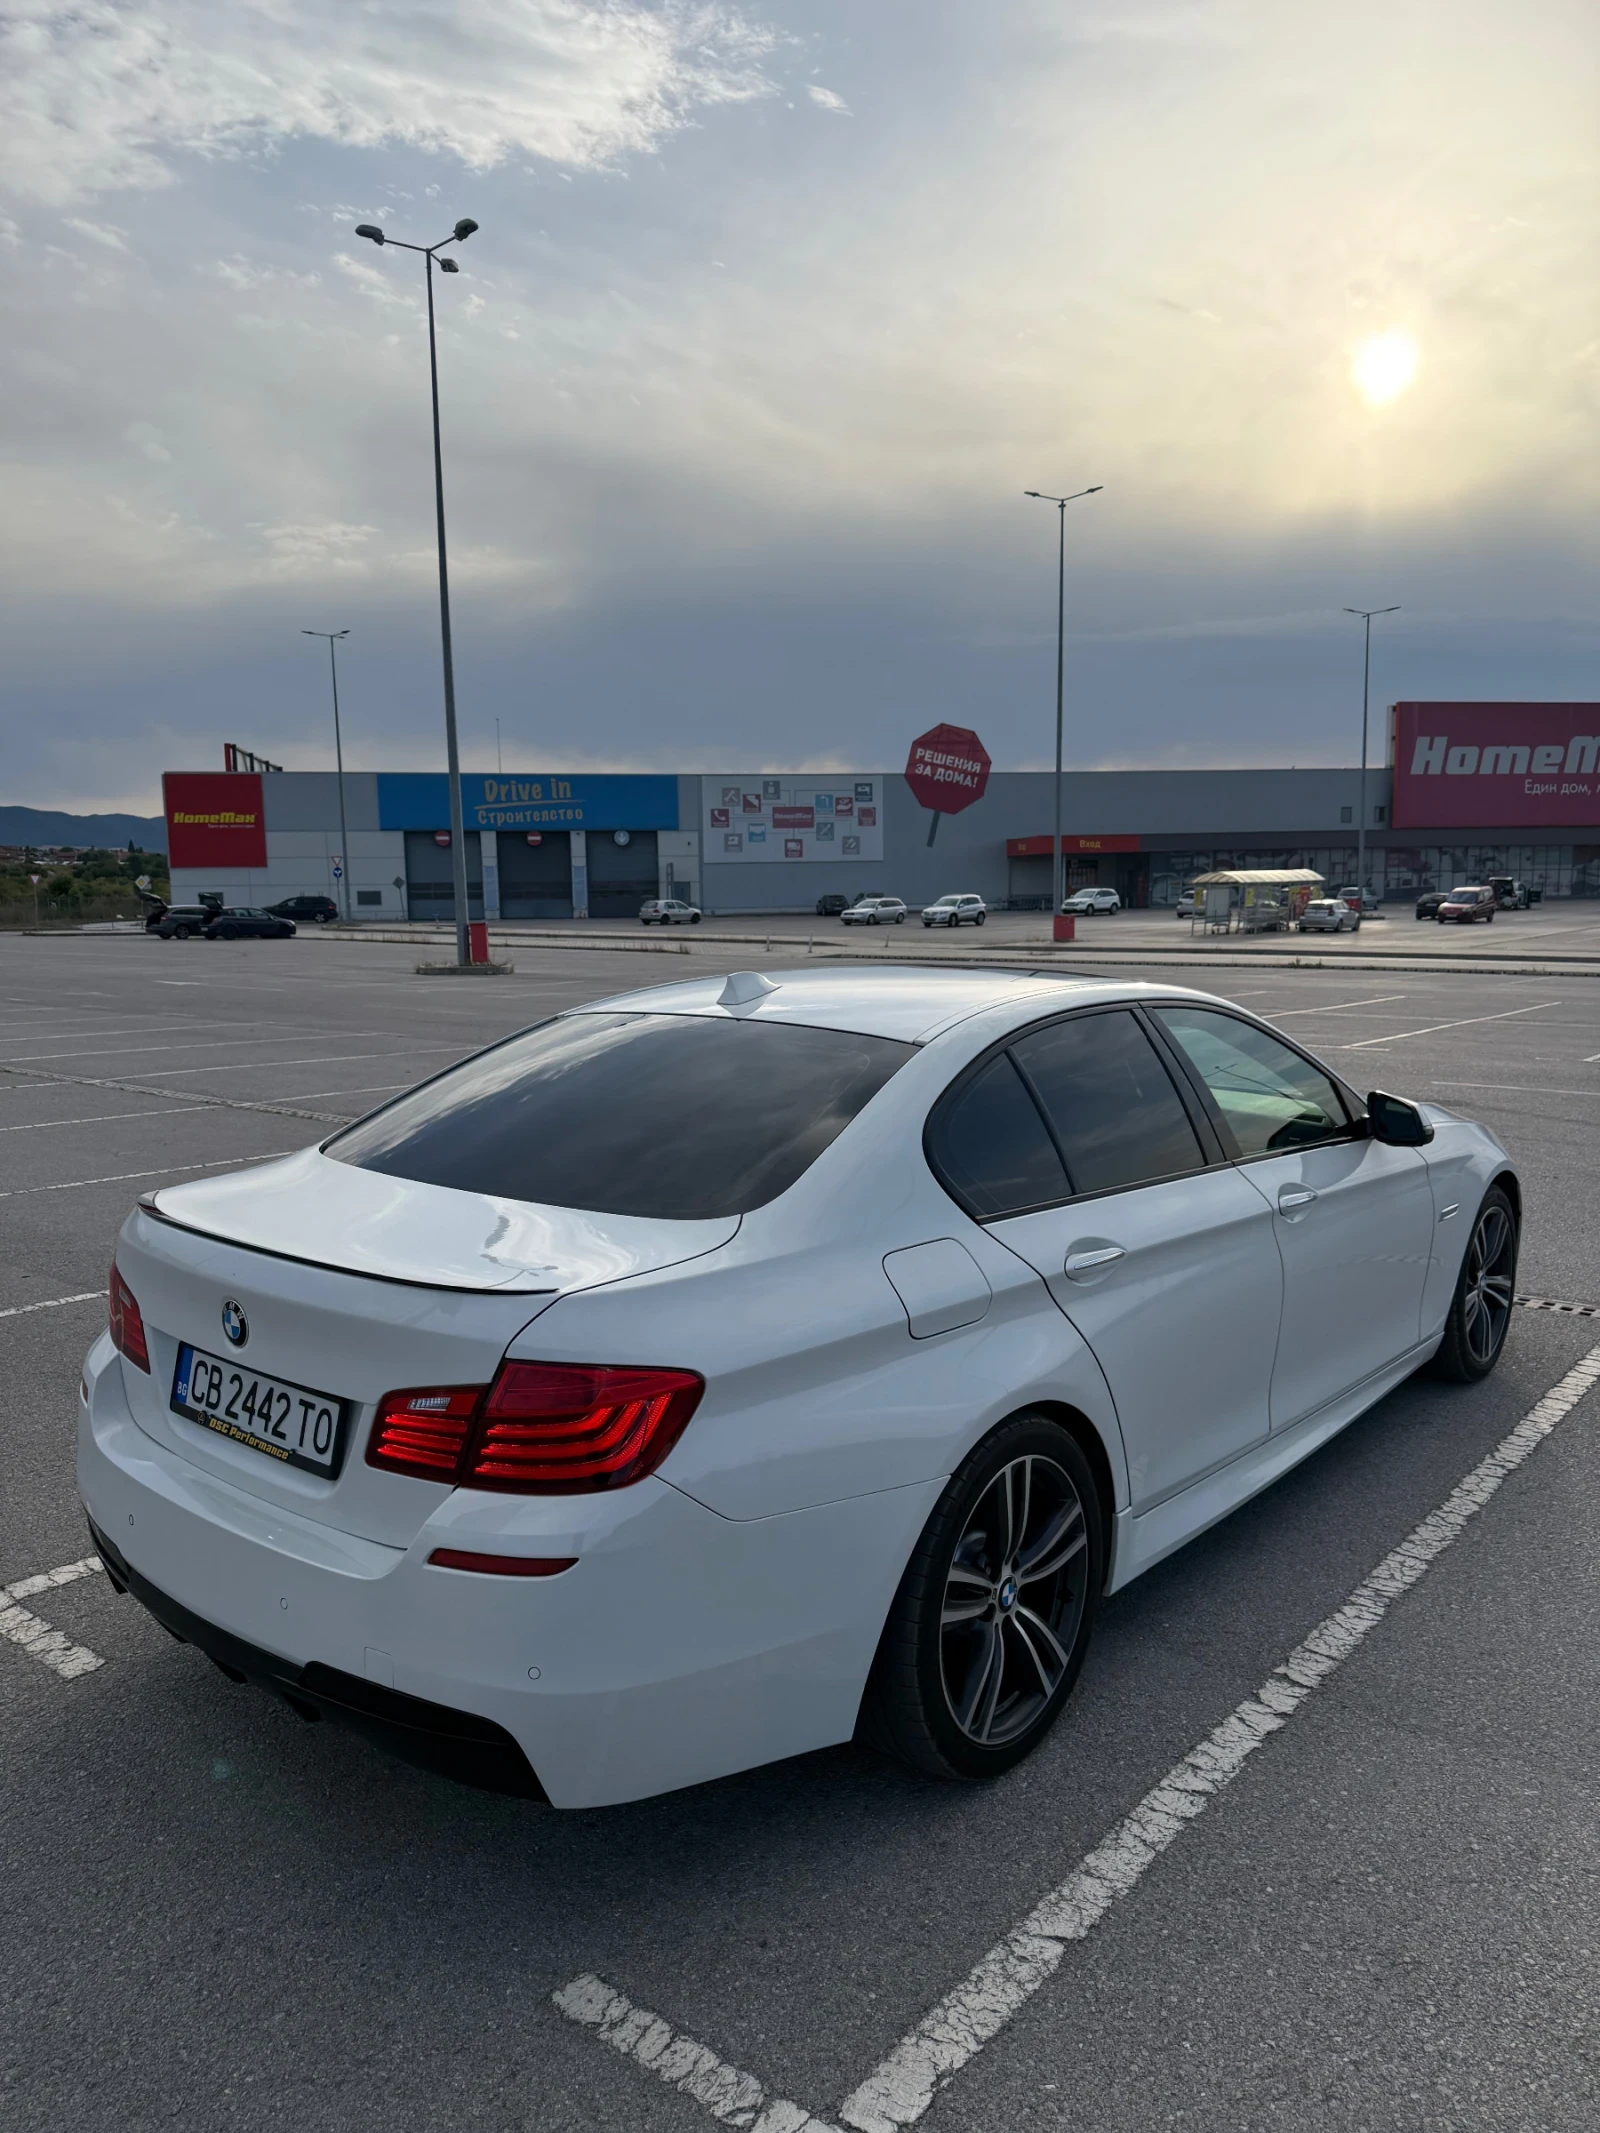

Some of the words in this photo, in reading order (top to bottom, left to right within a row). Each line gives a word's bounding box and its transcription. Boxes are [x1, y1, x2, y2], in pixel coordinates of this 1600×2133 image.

[916, 748, 981, 773] РЕШЕНИЯ
[915, 764, 932, 777] ЗА
[934, 768, 978, 788] ДОМА!
[484, 779, 542, 803] Drive
[551, 778, 572, 799] in
[1524, 779, 1557, 795] Един
[1560, 782, 1592, 796] дом,
[173, 812, 256, 824] HomeMax
[478, 808, 583, 827] Строителство
[1079, 840, 1101, 849] Вход
[223, 1302, 245, 1320] BMW
[177, 1381, 187, 1396] BG
[225, 1374, 291, 1440] 2442
[208, 1417, 229, 1433] DSC
[229, 1426, 289, 1460] Performance
